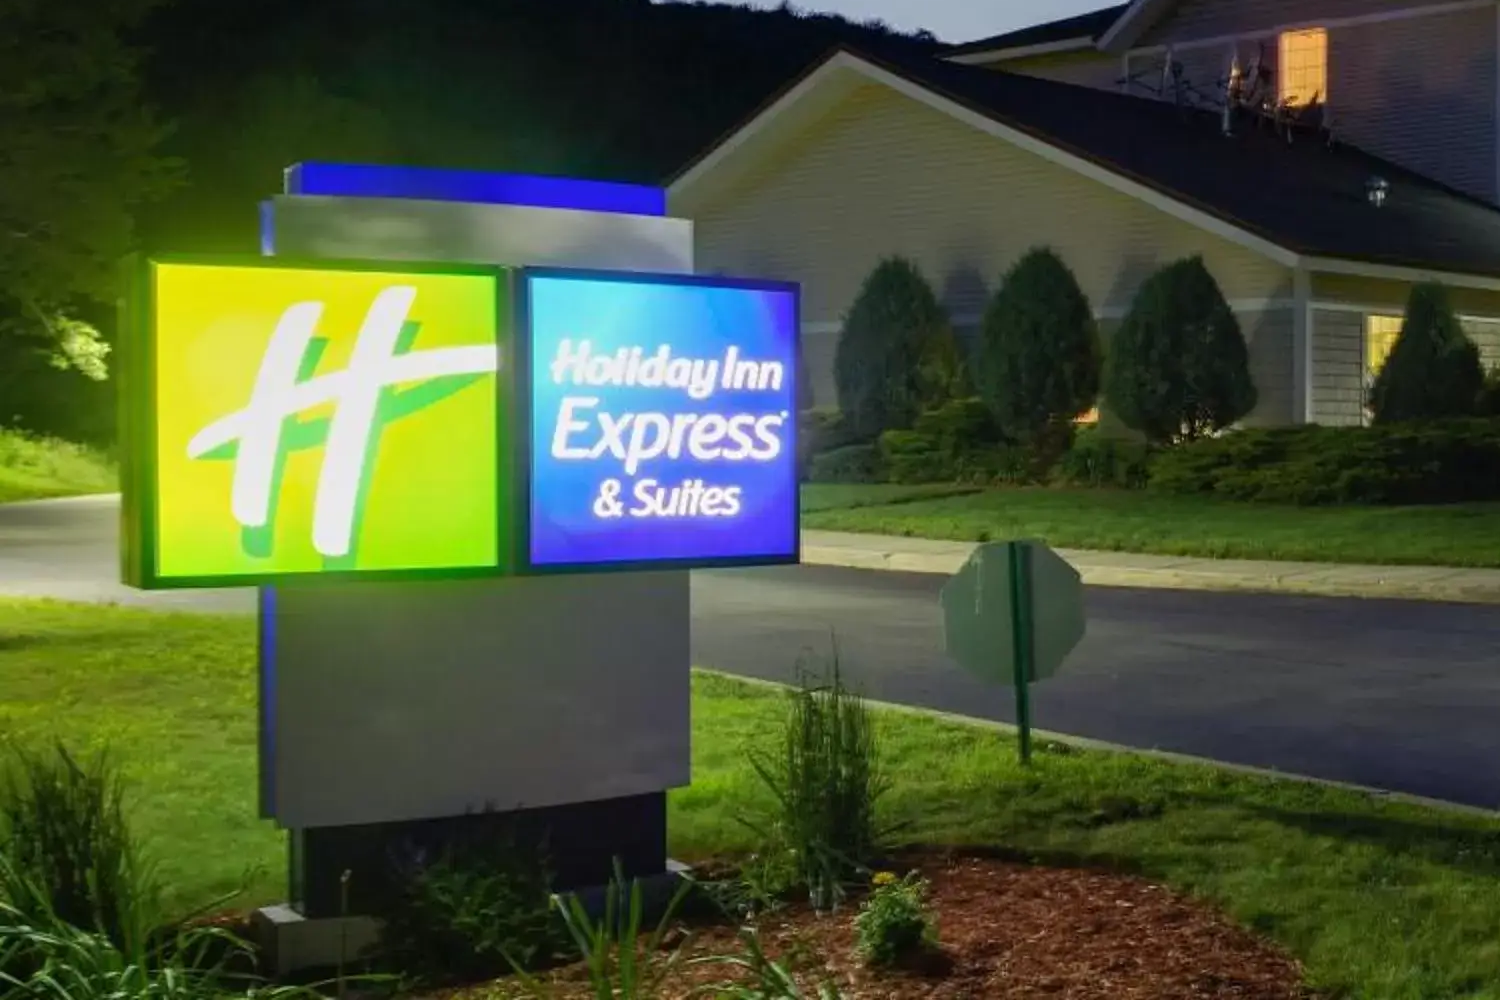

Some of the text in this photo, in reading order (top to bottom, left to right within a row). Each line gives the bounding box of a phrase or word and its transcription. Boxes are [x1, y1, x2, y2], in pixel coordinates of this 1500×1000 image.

[550, 338, 784, 399] Holiday Inn
[551, 396, 783, 476] Express
[593, 477, 742, 518] & Suites
